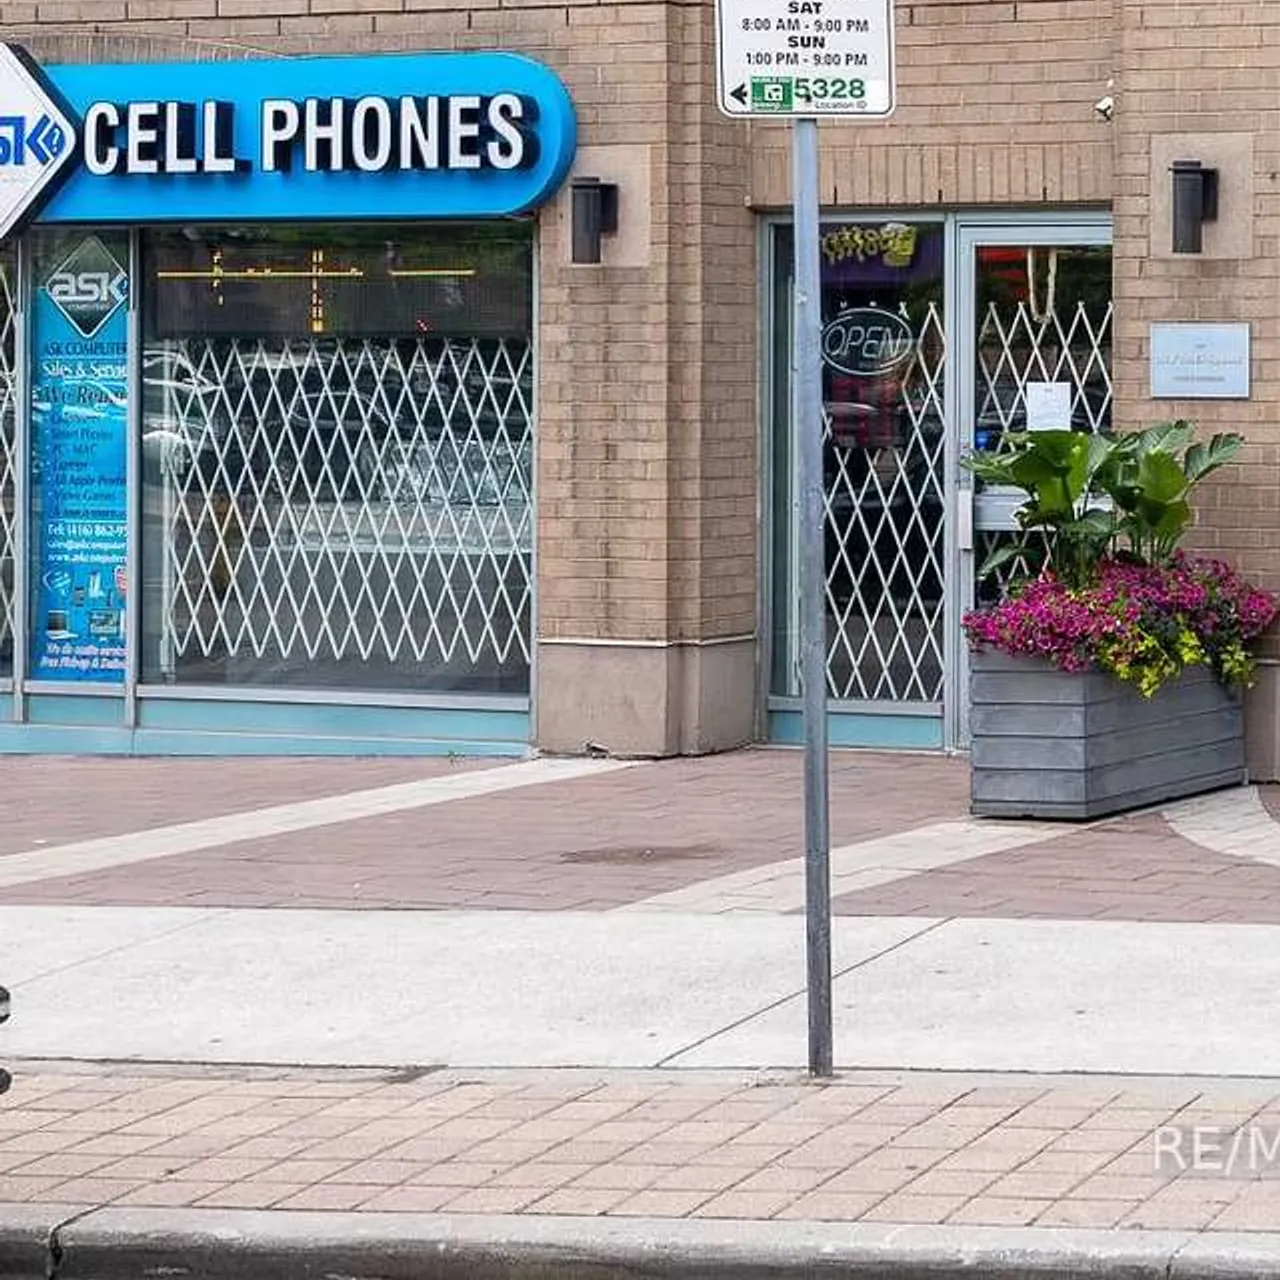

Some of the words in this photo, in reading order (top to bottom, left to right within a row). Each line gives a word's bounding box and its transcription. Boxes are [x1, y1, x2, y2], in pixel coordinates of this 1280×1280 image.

[788, 2, 823, 14] SAT
[776, 19, 800, 31] AM
[845, 20, 869, 32] PM
[788, 36, 825, 48] SUN
[776, 53, 799, 65] PM
[845, 54, 868, 66] PM
[794, 78, 865, 99] 5328
[84, 100, 237, 176] CELL
[261, 93, 524, 172] PHONES
[825, 326, 903, 358] OPEN
[42, 360, 73, 377] Sales
